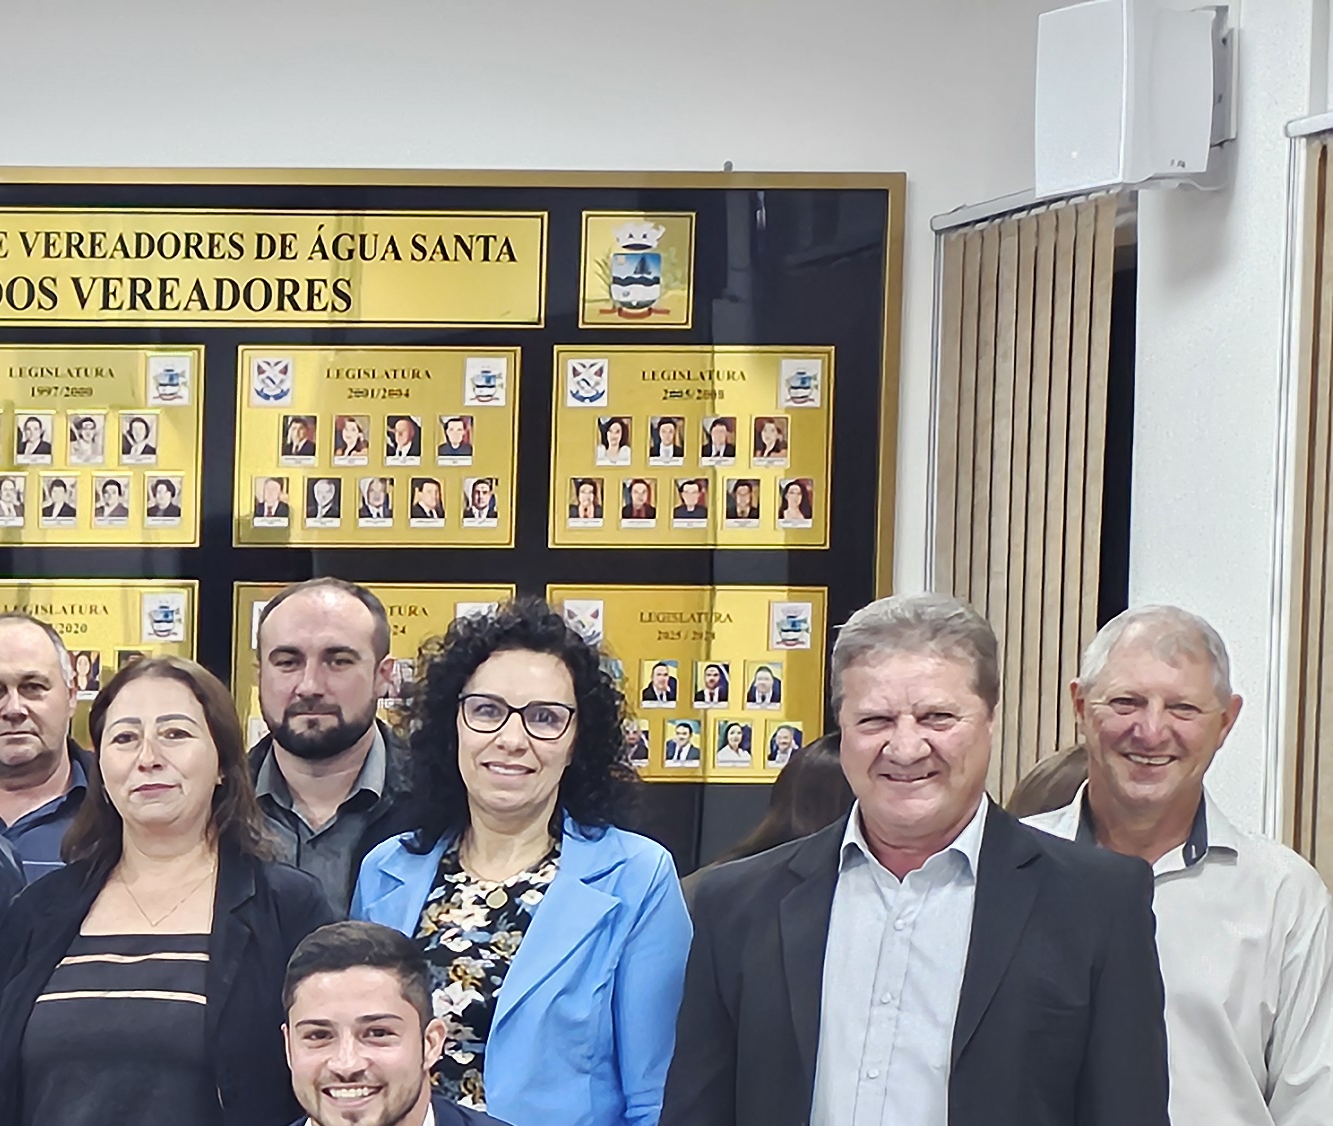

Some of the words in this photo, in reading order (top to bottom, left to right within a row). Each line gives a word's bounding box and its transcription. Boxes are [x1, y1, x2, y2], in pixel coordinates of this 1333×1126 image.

[19, 231, 244, 261] VEREADORES
[254, 232, 299, 261] DE
[308, 223, 402, 262] ÁGUA
[410, 234, 518, 263] SANTA
[70, 277, 352, 313] VEREADORES
[8, 366, 115, 379] LEGISLATURA
[325, 368, 432, 380] LEGISLATURA
[641, 370, 747, 382] LEGISLATURA
[639, 611, 733, 623] LEGISLATURA
